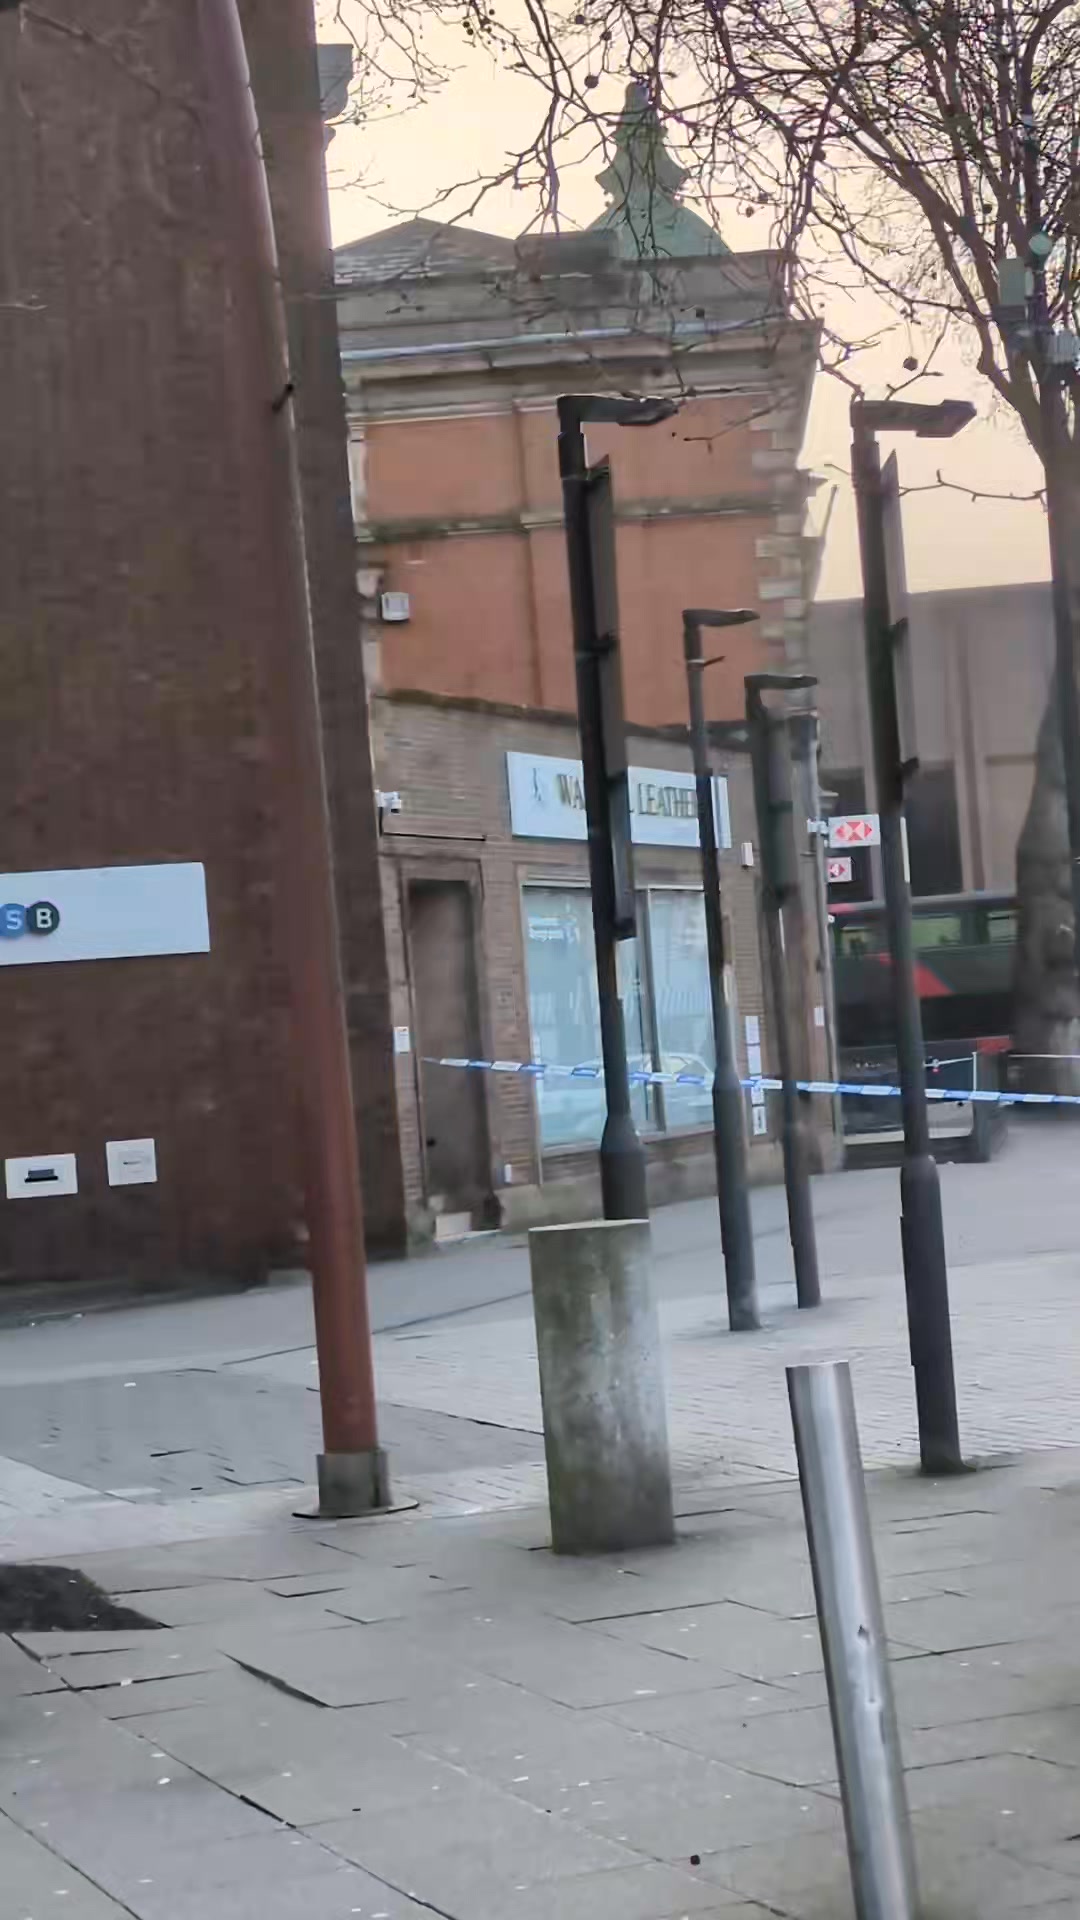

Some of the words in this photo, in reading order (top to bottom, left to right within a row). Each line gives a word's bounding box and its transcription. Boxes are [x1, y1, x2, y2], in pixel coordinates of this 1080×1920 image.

[638, 782, 698, 818] LEATHE
[6, 910, 23, 930] S
[36, 908, 53, 929] B
